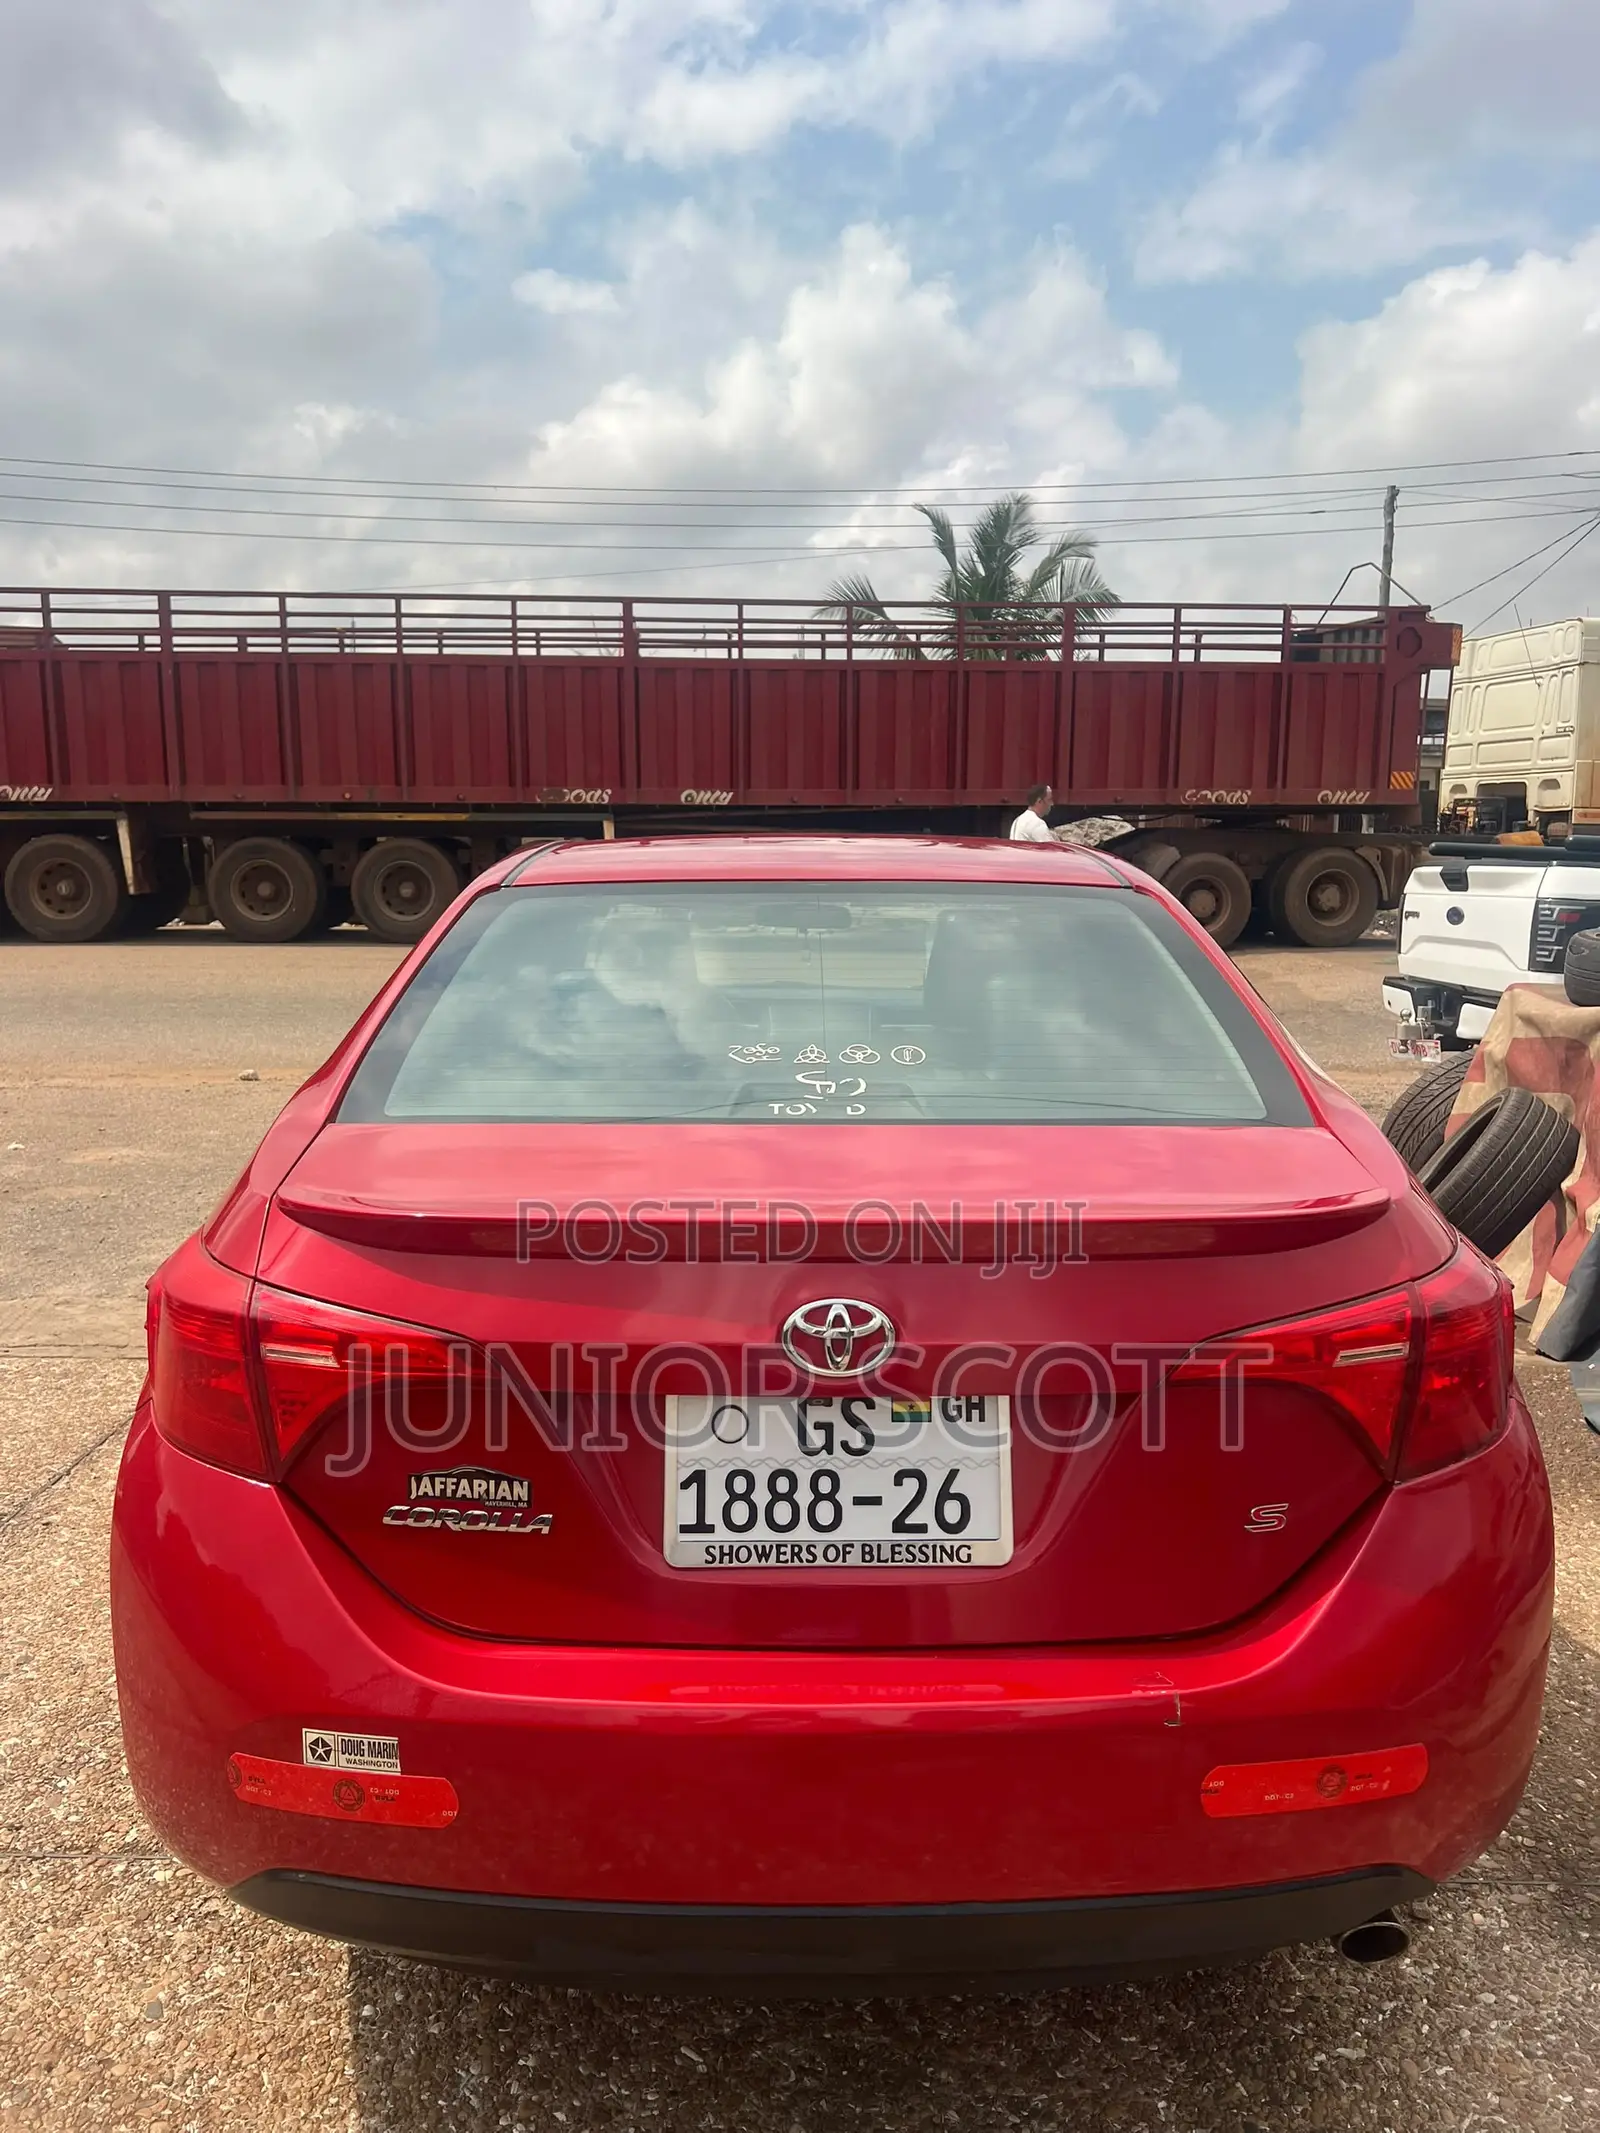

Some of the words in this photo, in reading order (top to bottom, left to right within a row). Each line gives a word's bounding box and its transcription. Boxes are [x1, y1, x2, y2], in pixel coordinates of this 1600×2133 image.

[941, 1396, 987, 1423] GH
[798, 1397, 876, 1456] GS
[409, 1476, 529, 1502] JAFFARIAN
[678, 1468, 972, 1535] 1888-26
[382, 1505, 553, 1535] COROLLA
[1244, 1503, 1289, 1533] S
[704, 1545, 817, 1565] SHOWERS
[822, 1545, 854, 1564] OF
[861, 1544, 972, 1564] BLESSING
[340, 1737, 366, 1758] DOUG
[345, 1757, 398, 1769] WASHINGTON
